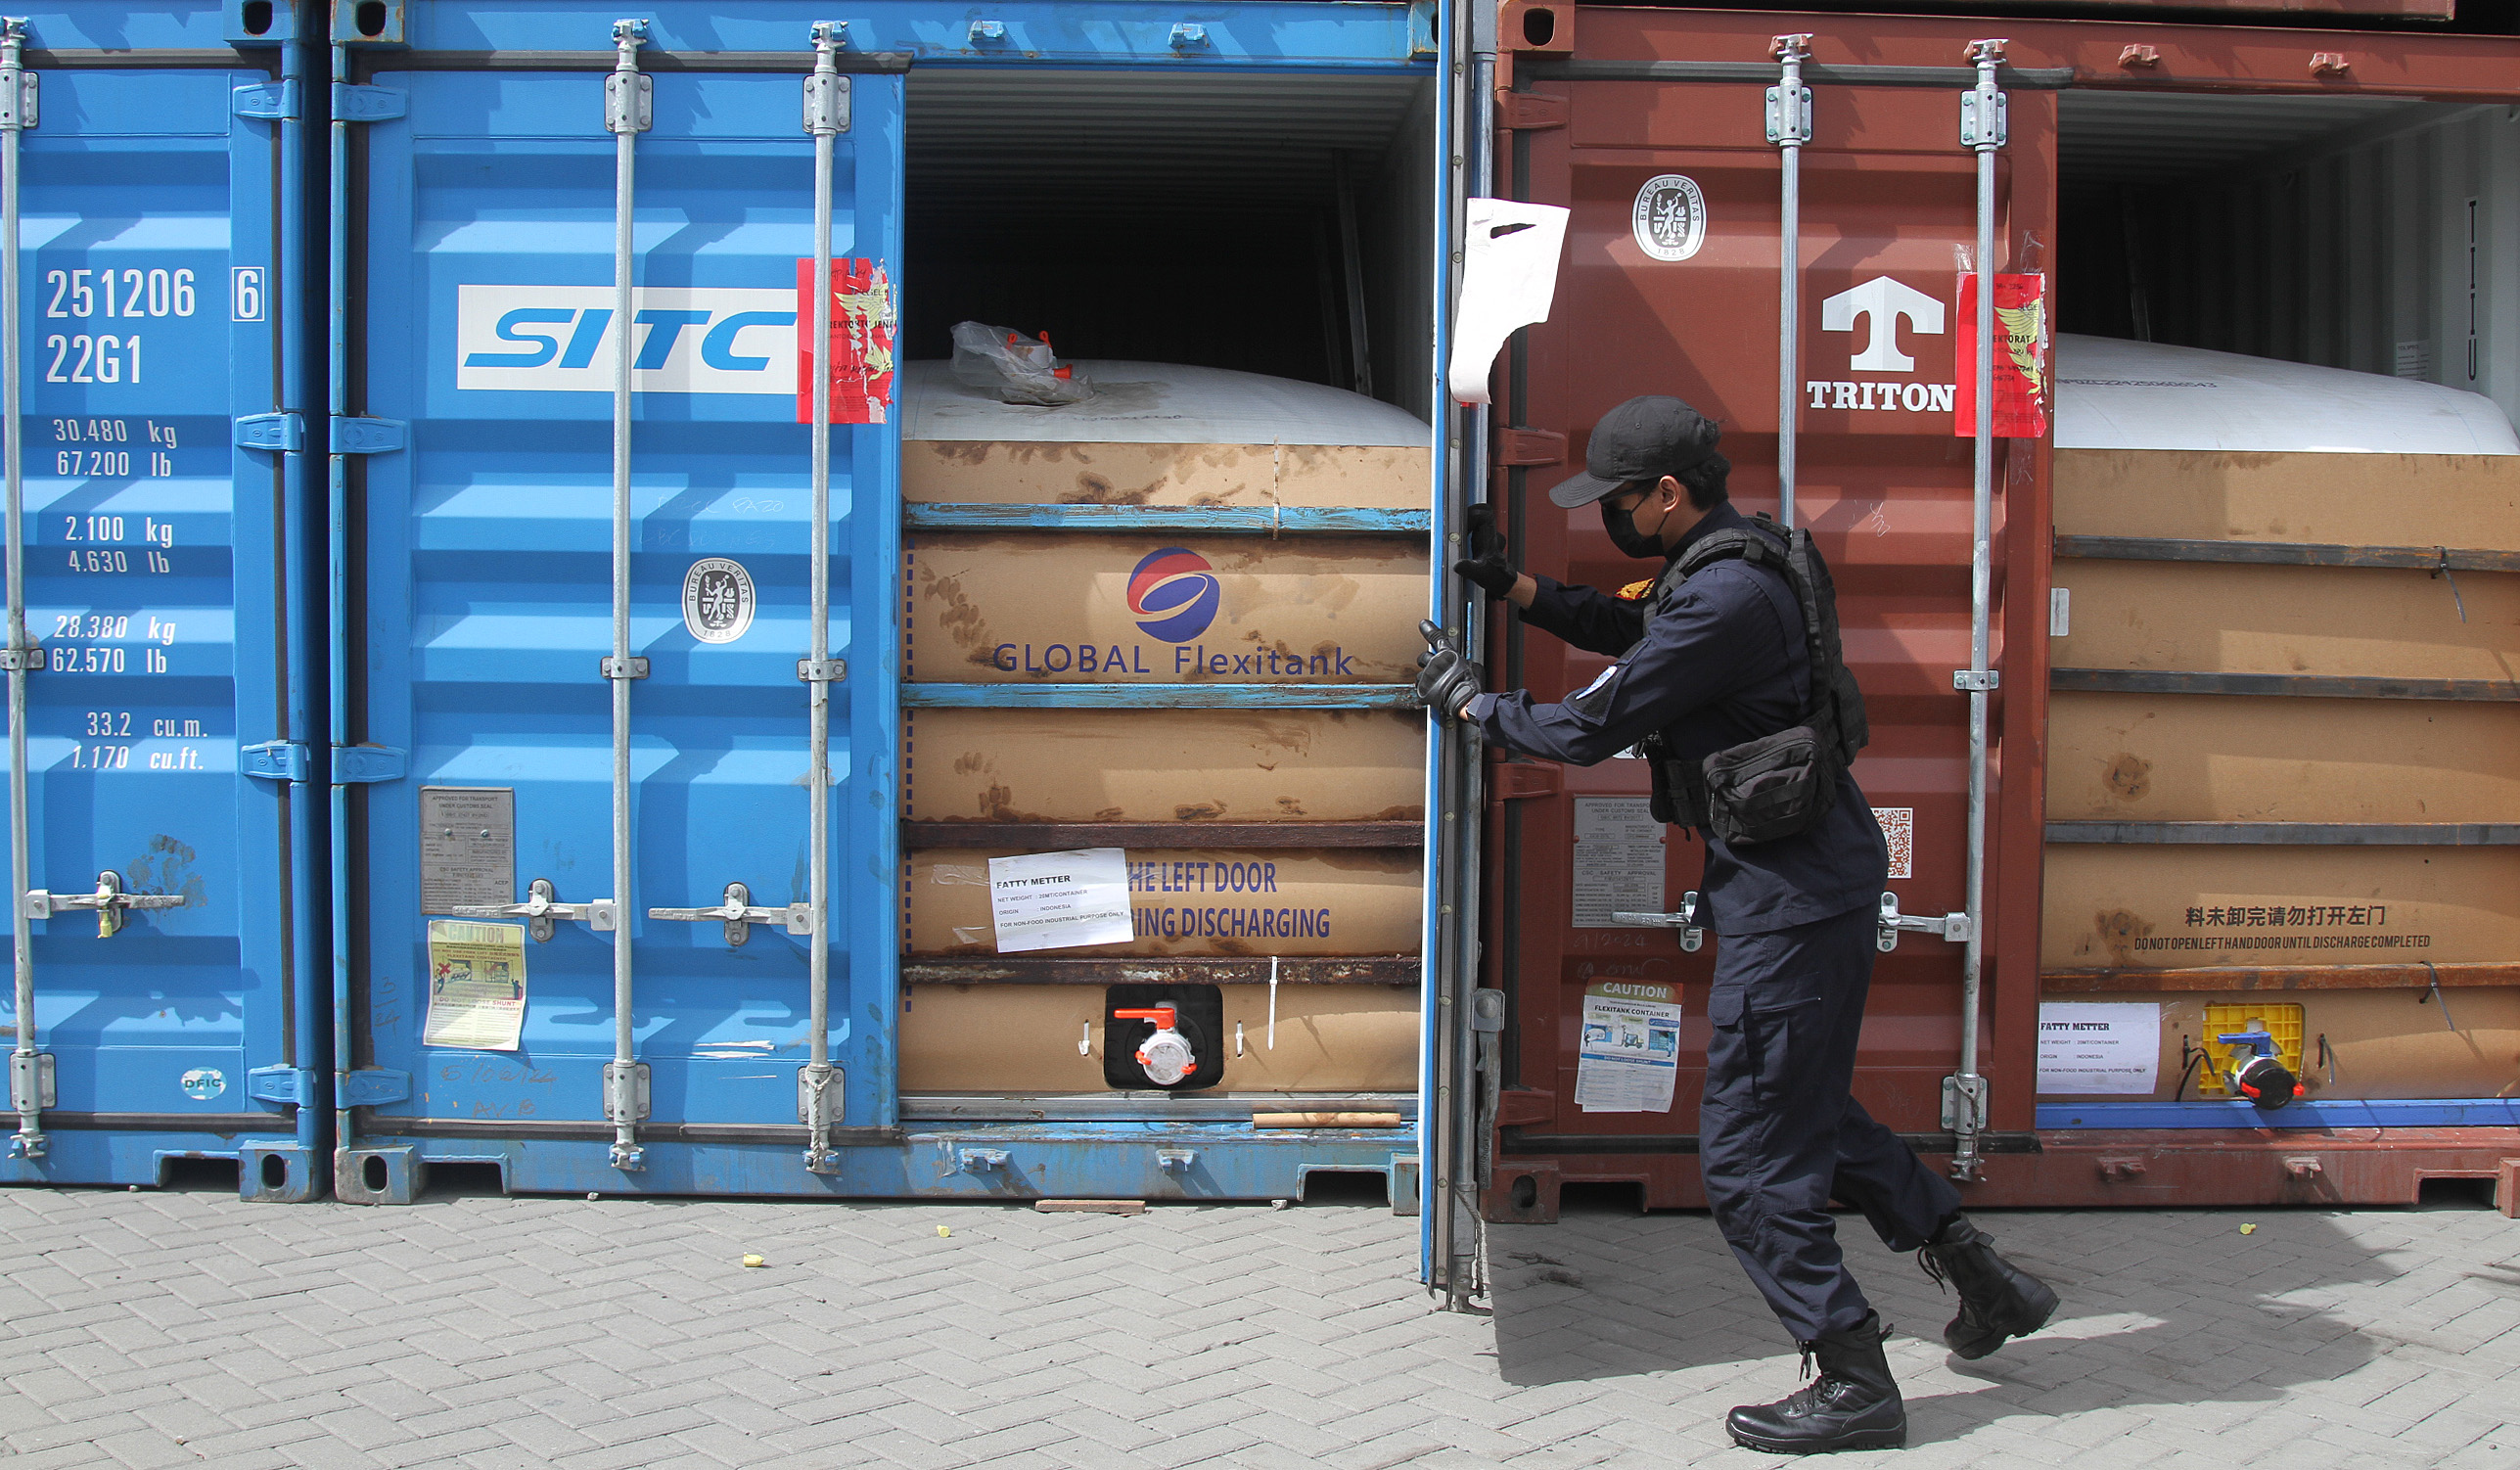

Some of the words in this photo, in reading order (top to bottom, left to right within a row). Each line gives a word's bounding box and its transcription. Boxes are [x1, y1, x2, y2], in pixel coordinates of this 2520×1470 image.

[1640, 180, 1669, 221] BUREAU
[1673, 180, 1700, 222] VERITAS
[47, 268, 196, 317] 251206
[237, 269, 259, 319] 6
[464, 307, 799, 371] SITC
[46, 335, 142, 383] 22G1
[1807, 381, 1957, 412] TRITON
[148, 420, 177, 449] kg
[151, 453, 172, 478] lb
[146, 518, 174, 547] kg
[148, 551, 170, 574] lb
[689, 563, 715, 602] BUREAU
[719, 563, 750, 603] VERITAS
[147, 616, 177, 645] kg
[146, 649, 167, 673] lb
[993, 643, 1151, 674] GLOBAL
[1174, 646, 1354, 676] Flexitank
[87, 712, 132, 737] 33.2
[154, 714, 208, 738] cu.m.
[150, 746, 205, 770] cu.ft.
[996, 879, 1029, 889] FATTY
[1031, 875, 1071, 886] METTER
[1126, 861, 1156, 892] HE
[1162, 862, 1209, 893] LEFT
[1214, 861, 1277, 893] DOOR
[1182, 907, 1330, 938] DISCHARGING
[2184, 905, 2386, 927] 料未卸完请勿打开左门
[447, 924, 504, 943] CAUTION
[2134, 938, 2149, 950] DO
[2149, 938, 2170, 949] NOT
[2172, 937, 2199, 949] OPEN
[2200, 937, 2223, 949] LEFT
[2224, 937, 2254, 949] HAND
[2254, 937, 2282, 949] DOOR
[2282, 936, 2312, 948] UNTIL
[2313, 936, 2370, 948] DISCHARGE
[2370, 935, 2431, 948] COMPLETED
[1603, 982, 1668, 998] CAUTION
[1594, 1004, 1630, 1015] FLEXITANK
[1631, 1008, 1670, 1018] CONTAINER
[2040, 1022, 2070, 1031] FATTY
[185, 1079, 222, 1088] DFIC
